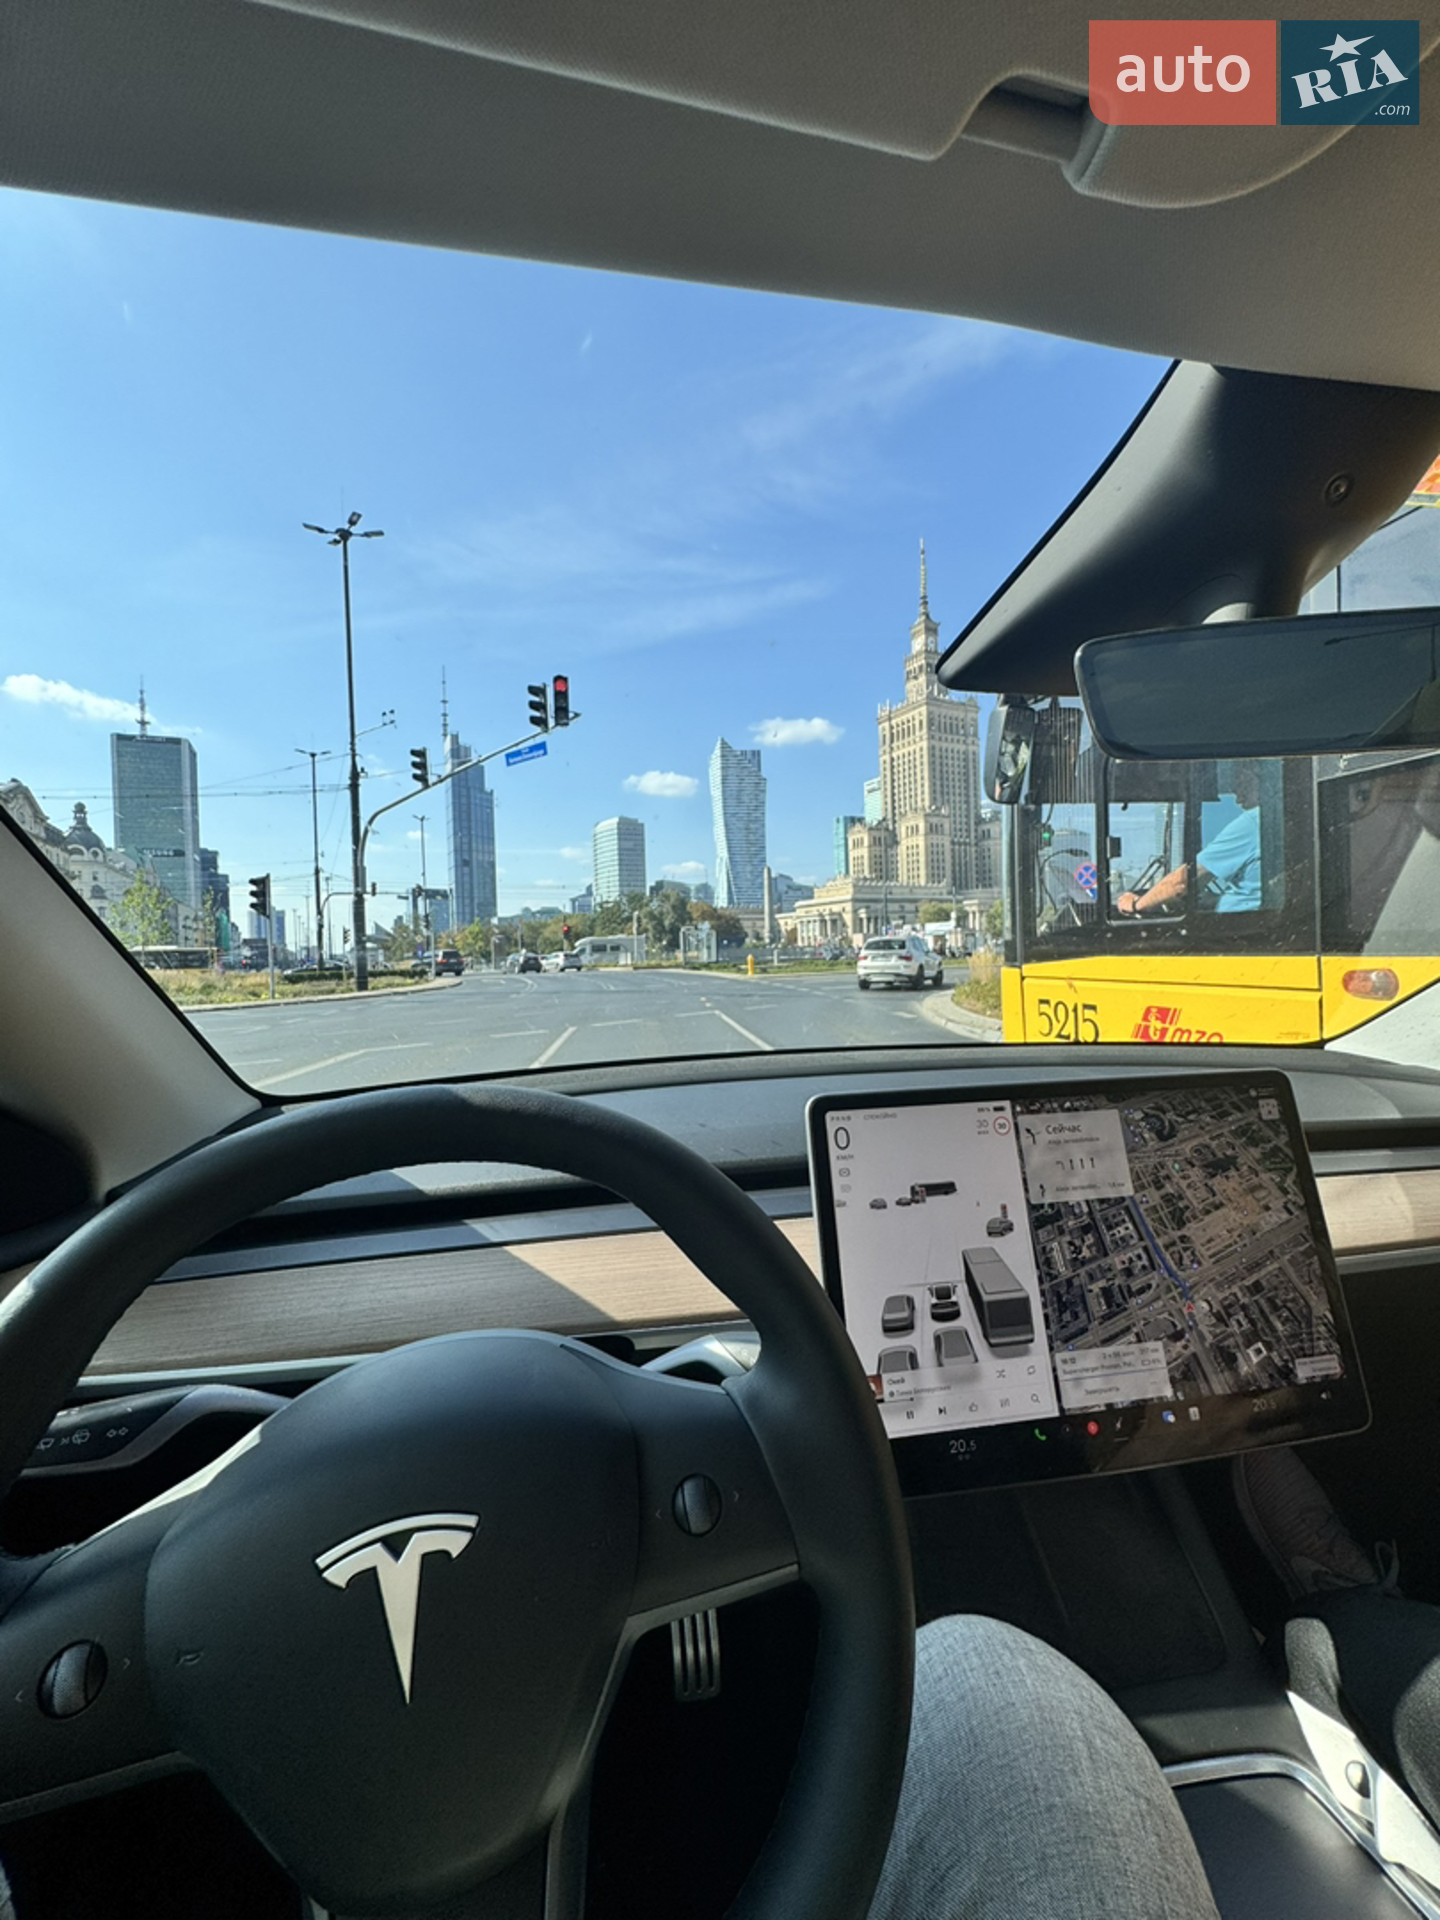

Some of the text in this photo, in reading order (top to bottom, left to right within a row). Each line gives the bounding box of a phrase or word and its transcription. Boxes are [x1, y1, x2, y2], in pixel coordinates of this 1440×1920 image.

[1037, 998, 1100, 1043] 5215
[834, 1126, 851, 1151] 0
[1045, 1123, 1082, 1135] Сейчас
